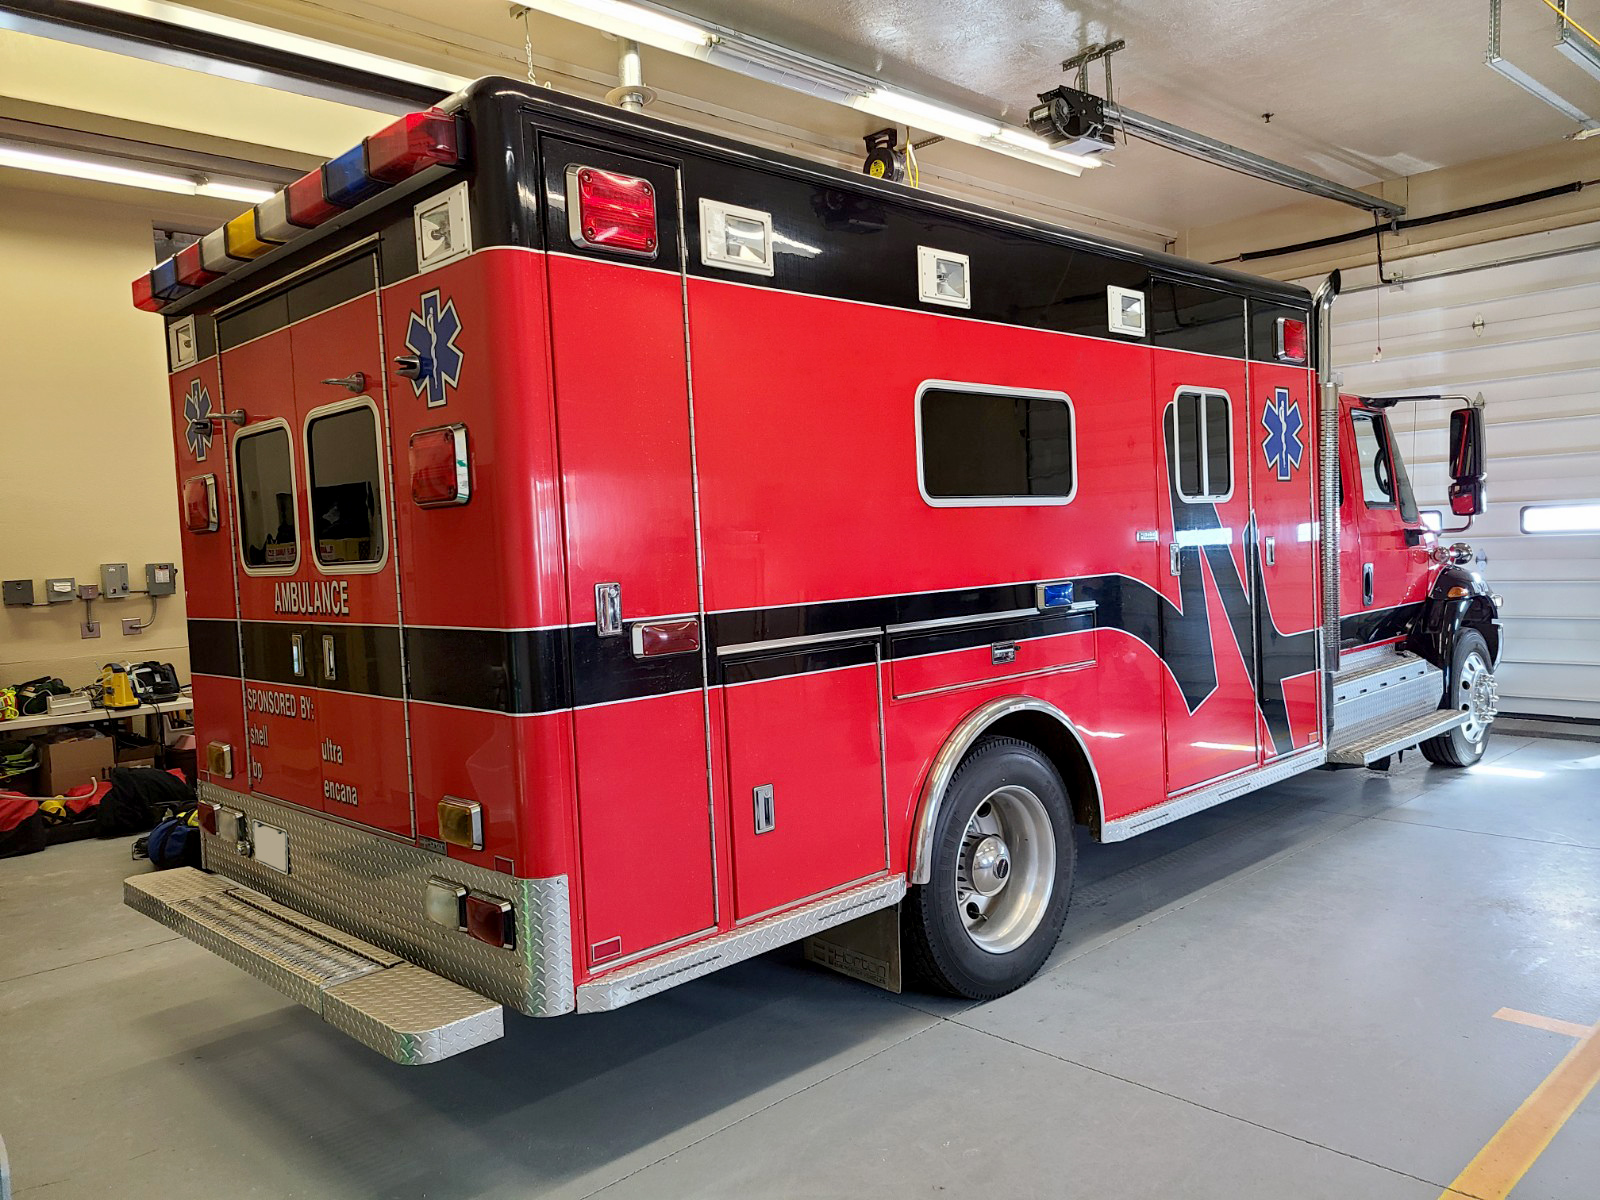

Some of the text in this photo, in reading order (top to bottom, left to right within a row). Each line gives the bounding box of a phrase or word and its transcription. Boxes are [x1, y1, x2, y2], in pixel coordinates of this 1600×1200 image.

[274, 580, 349, 615] AMBULANCE
[247, 689, 315, 719] SPONSORED BY:
[250, 725, 269, 747] shell
[321, 738, 343, 763] ultra
[324, 780, 358, 805] encana
